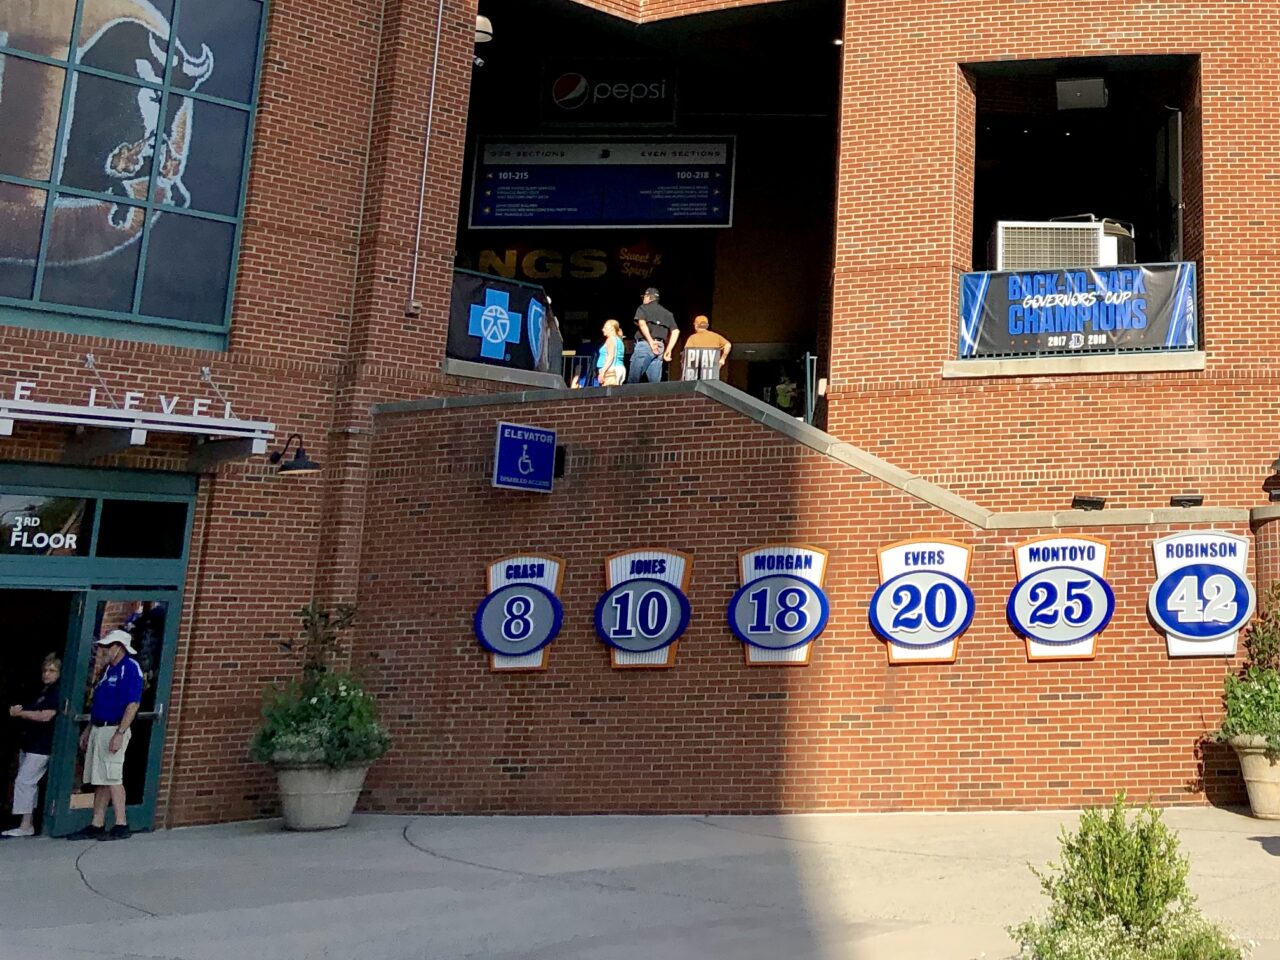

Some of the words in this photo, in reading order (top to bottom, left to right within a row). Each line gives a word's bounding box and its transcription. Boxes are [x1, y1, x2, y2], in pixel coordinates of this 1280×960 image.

[593, 79, 666, 103] pepsi
[498, 171, 529, 180] 101-215
[1008, 269, 1147, 300] BACK-TO-BACK
[1104, 290, 1133, 305] CUP
[1008, 298, 1148, 336] CHAMPIONS
[1048, 336, 1067, 347] 2017
[88, 388, 241, 420] LEVEL
[503, 428, 554, 444] ELEVATOR
[12, 516, 40, 531] 3RD
[10, 531, 77, 549] FLOOR
[904, 550, 945, 566] EVERS
[1029, 546, 1096, 563] MONTOYO
[1166, 542, 1238, 559] ROBINSON
[505, 563, 544, 579] CRASH
[630, 559, 666, 575] JONES
[754, 555, 813, 571] MORGAN
[889, 581, 958, 633] 20
[1028, 579, 1093, 628] 25
[1167, 574, 1238, 623] 42
[501, 595, 534, 641] 8
[610, 589, 672, 639] 10
[747, 586, 811, 635] 18
